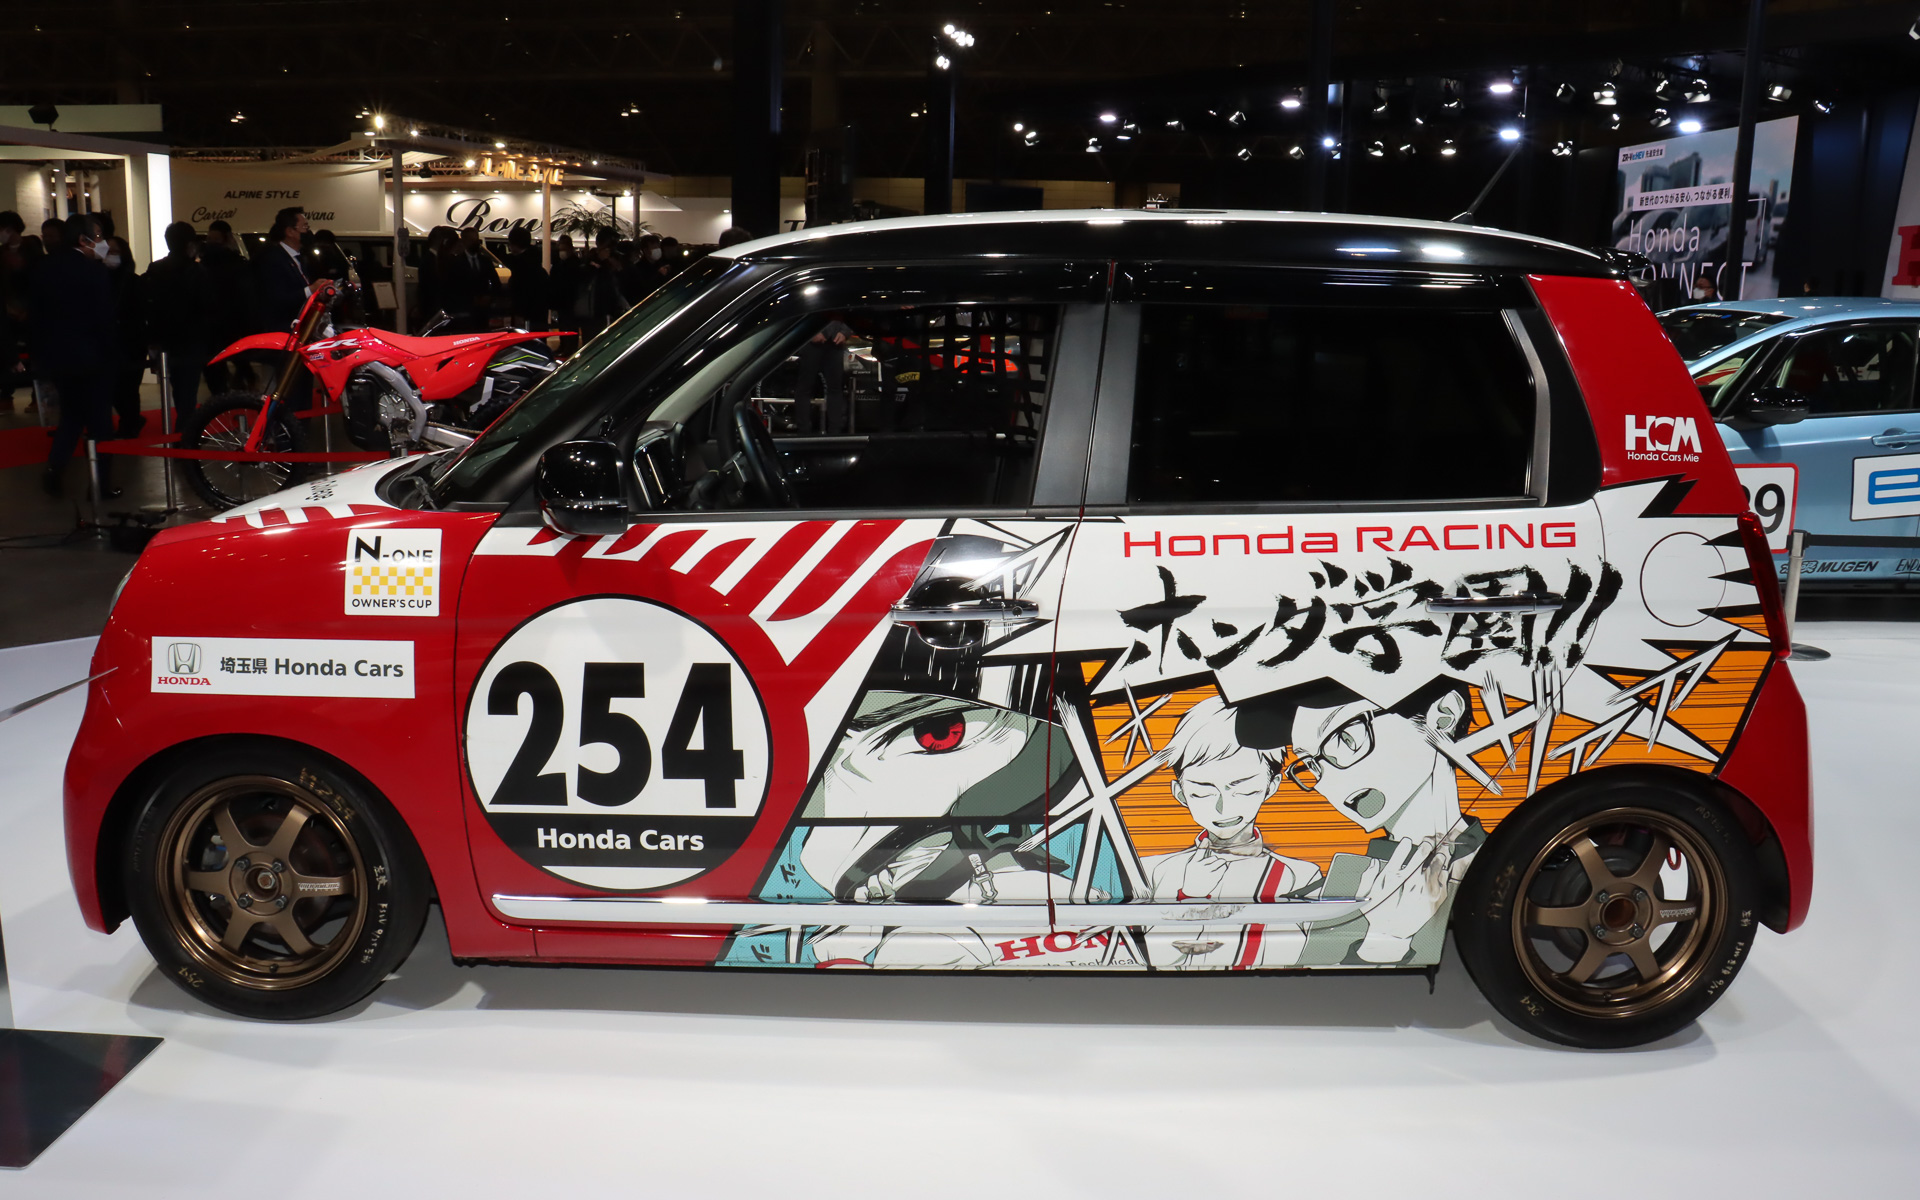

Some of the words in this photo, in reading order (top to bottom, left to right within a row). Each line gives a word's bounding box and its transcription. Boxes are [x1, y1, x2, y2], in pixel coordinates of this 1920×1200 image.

[478, 157, 525, 180] ALPINE
[526, 163, 565, 186] STYLE
[224, 190, 264, 199] ALPINE
[265, 190, 300, 199] STYLE
[1628, 212, 1701, 253] Honda
[1625, 414, 1703, 453] HCM
[1627, 451, 1659, 461] Honda
[1660, 452, 1682, 462] Cars
[1683, 453, 1700, 463] Mie
[354, 535, 434, 563] N-ONE
[1123, 525, 1339, 557] Honda
[1356, 521, 1577, 552] RACING
[1816, 560, 1880, 573] MUGEN
[351, 598, 406, 608] OWNER'S
[407, 599, 433, 609] CUP
[220, 657, 268, 675] 埼玉県
[274, 658, 347, 677] Honda
[354, 659, 404, 678] Cars
[157, 676, 212, 686] HONDA
[487, 660, 745, 809] 254
[536, 827, 632, 851] Honda
[639, 829, 705, 852] Cars
